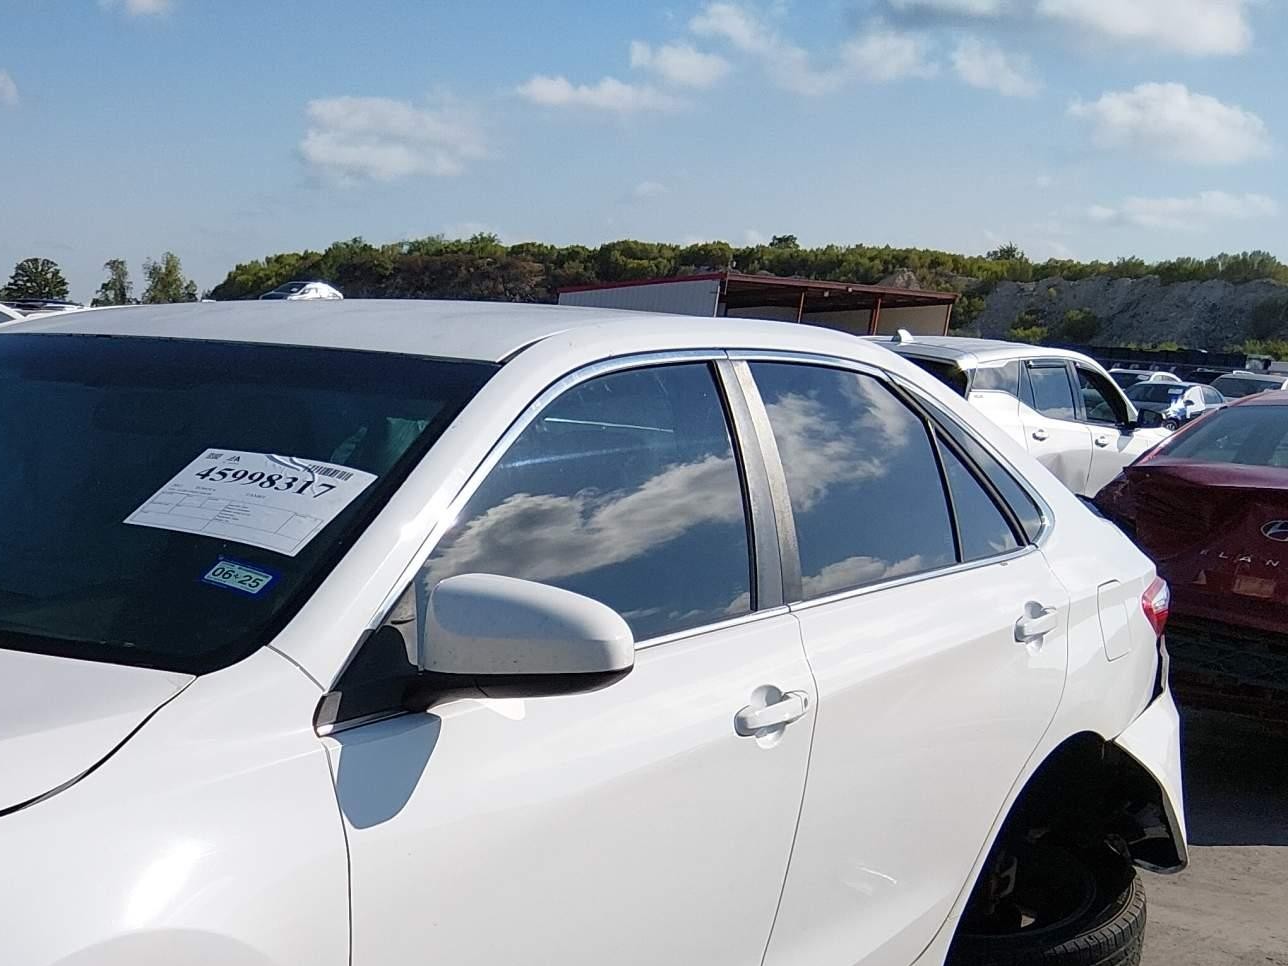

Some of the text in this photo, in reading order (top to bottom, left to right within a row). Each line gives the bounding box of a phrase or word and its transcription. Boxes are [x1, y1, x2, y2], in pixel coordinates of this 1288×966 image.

[195, 465, 336, 498] 45998317
[211, 567, 264, 588] 06 25
